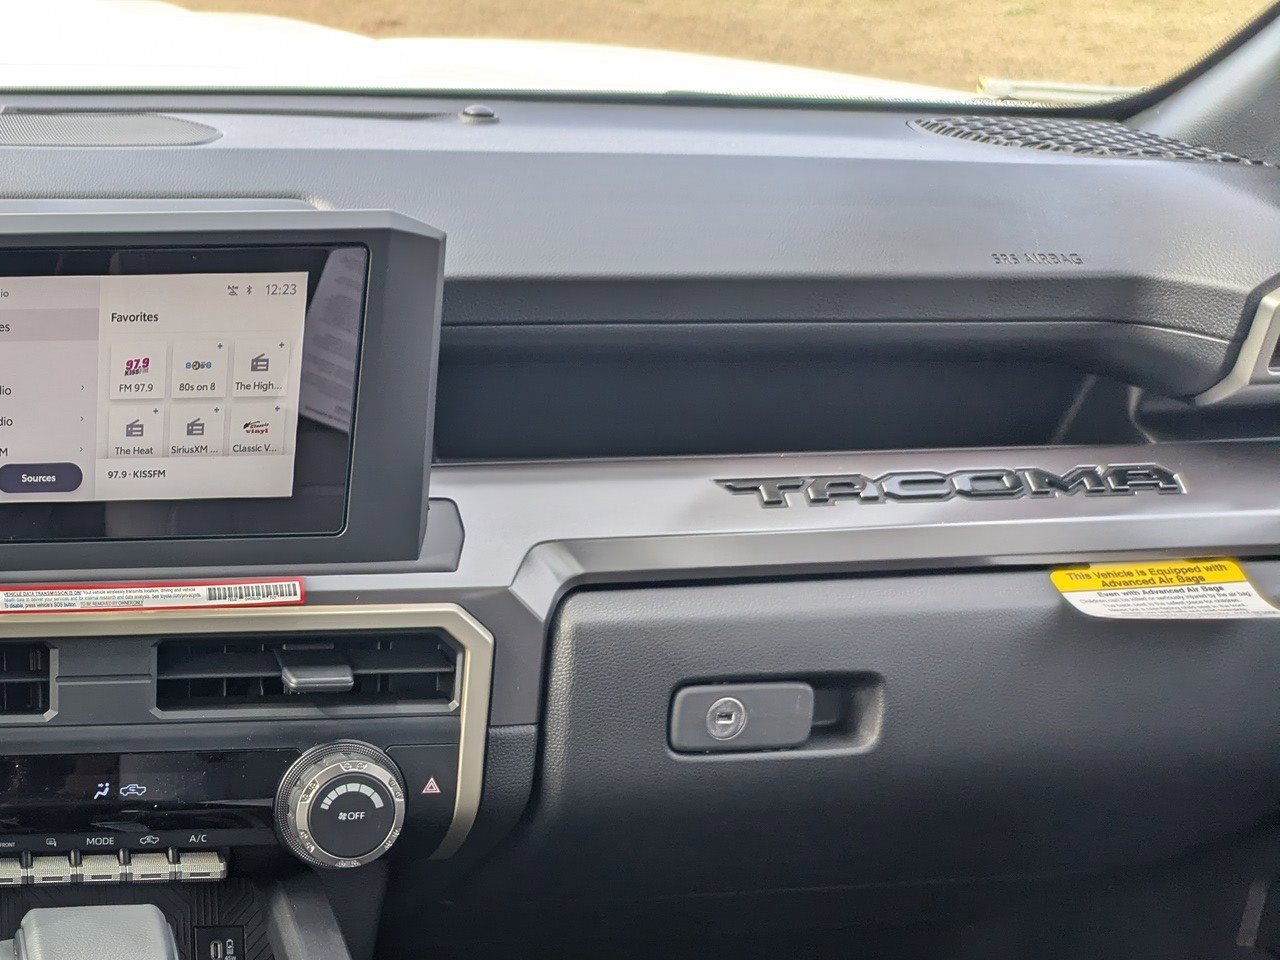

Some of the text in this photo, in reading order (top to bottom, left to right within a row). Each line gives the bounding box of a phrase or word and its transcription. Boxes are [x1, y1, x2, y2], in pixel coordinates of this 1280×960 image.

[991, 253, 1084, 264] SRS AIRBAG
[266, 284, 296, 296] 12:23
[111, 312, 158, 322] Favorites
[125, 358, 150, 370] 97.9
[118, 384, 154, 392] FM 97.9
[178, 383, 194, 391] 80s
[210, 382, 216, 390] 8
[235, 382, 252, 390] The
[115, 446, 154, 455] The Heat
[171, 445, 208, 454] SiriusXM
[232, 444, 260, 453] Classic
[21, 474, 56, 482] Sources
[108, 470, 166, 479] 97.9 KISSFM
[713, 461, 1188, 508] TACOMA
[1066, 572, 1092, 581] This
[1093, 570, 1134, 579] Vehicle
[1148, 566, 1201, 577] Equipped
[1203, 564, 1227, 572] with
[1102, 575, 1205, 587] Advanced Air Bags
[347, 811, 366, 820] OFF
[86, 836, 114, 845] MODE
[189, 834, 207, 843] A/C
